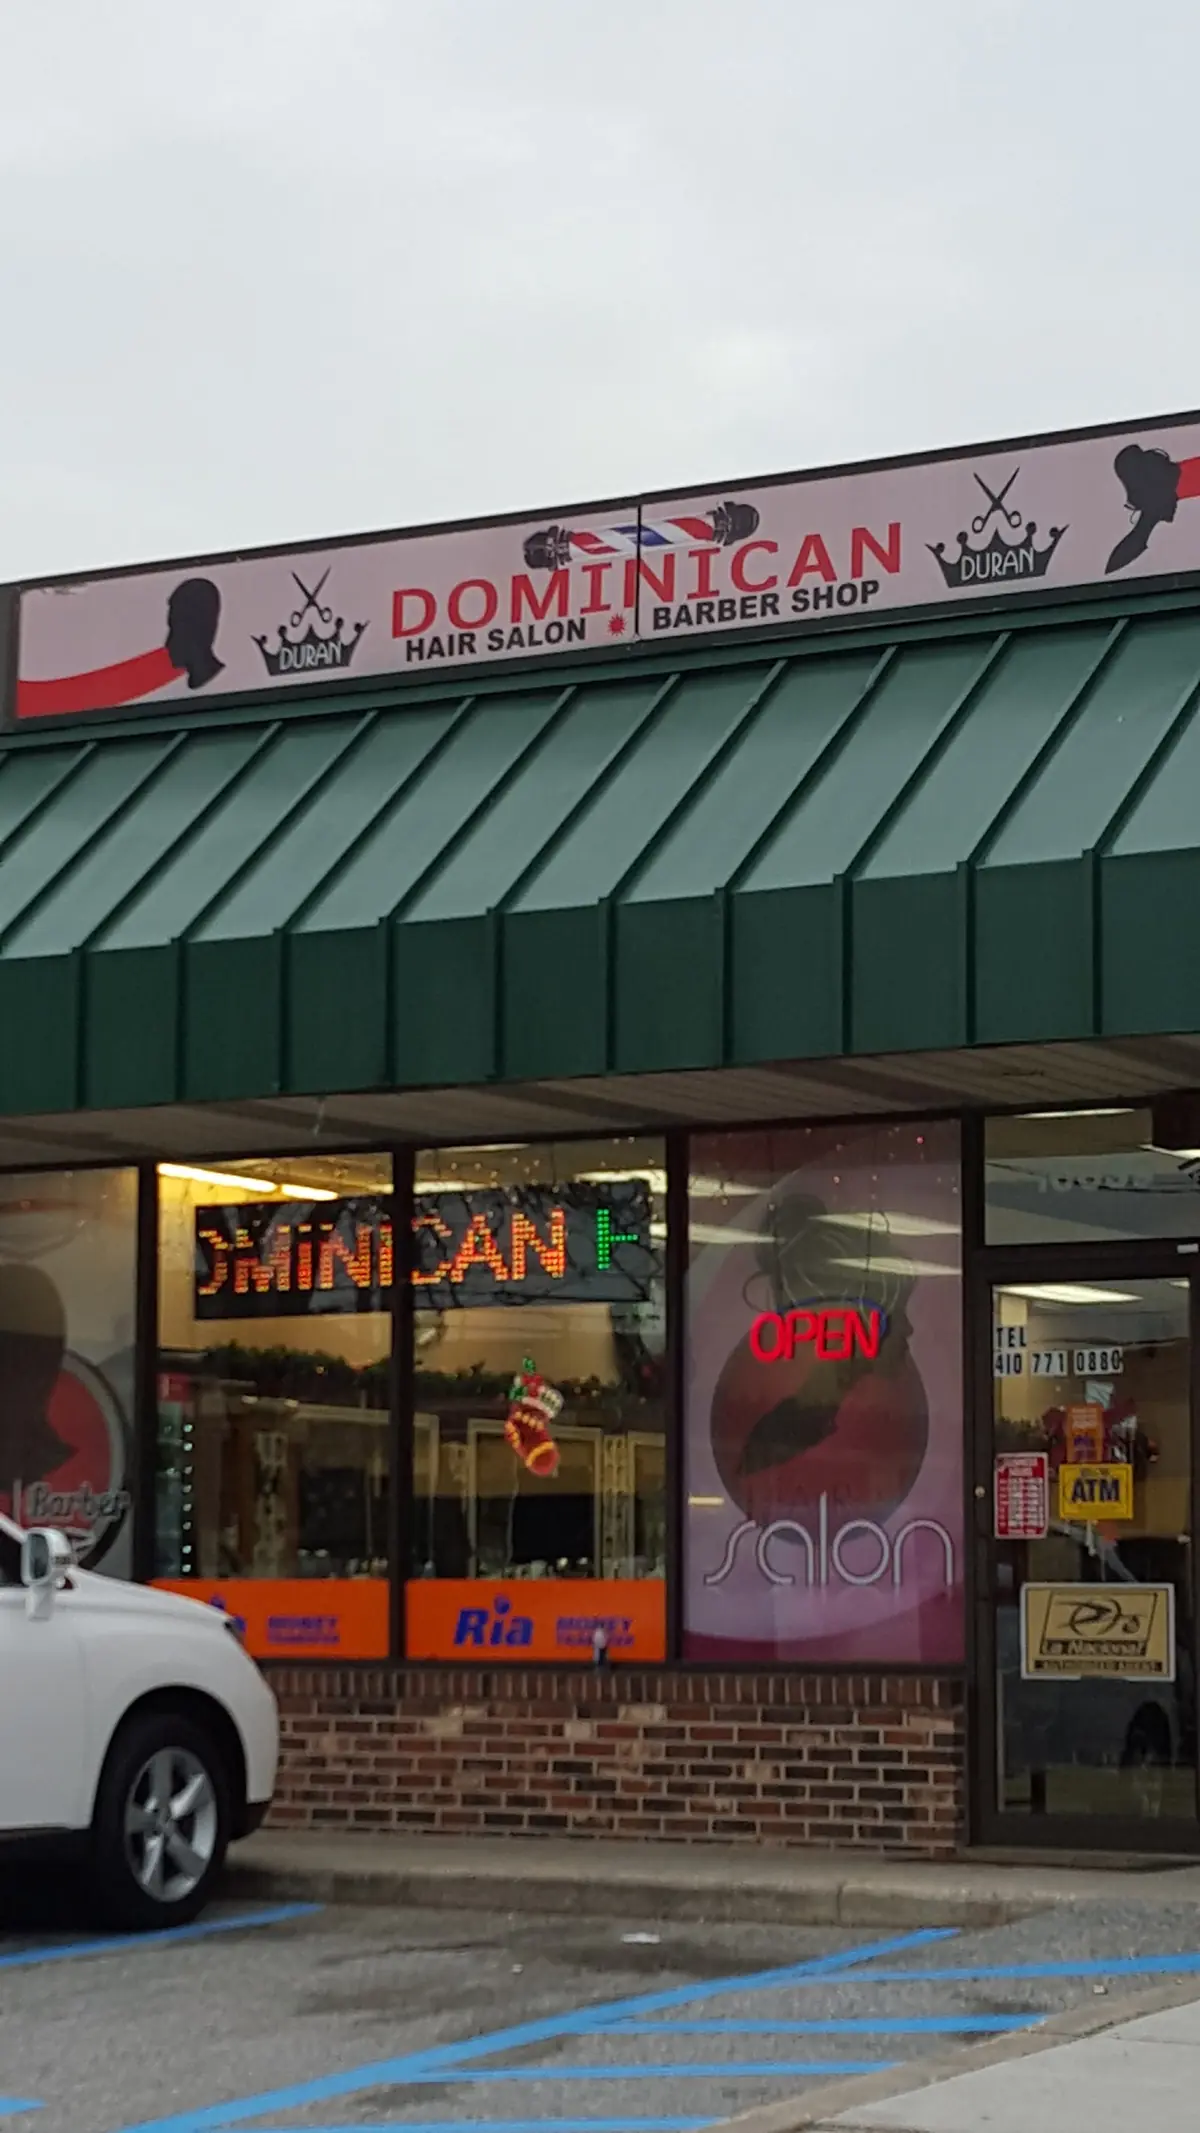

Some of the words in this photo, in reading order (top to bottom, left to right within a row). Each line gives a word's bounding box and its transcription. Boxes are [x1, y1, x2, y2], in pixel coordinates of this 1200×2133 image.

[391, 522, 901, 639] DOMINICAN
[960, 547, 1035, 581] DURAN
[653, 593, 780, 630] BARBER
[791, 579, 880, 613] SHOP
[279, 640, 342, 671] DURAN
[405, 631, 477, 662] HAIR
[487, 618, 586, 651] SALON
[750, 1309, 881, 1363] OPEN
[996, 1327, 1027, 1348] TEL
[995, 1352, 1022, 1375] 410
[1031, 1352, 1065, 1373] 771
[1076, 1349, 1121, 1373] 0880
[27, 1481, 131, 1520] Barber
[1071, 1478, 1120, 1503] ATM
[703, 1488, 956, 1588] salon
[453, 1594, 534, 1646] Ria
